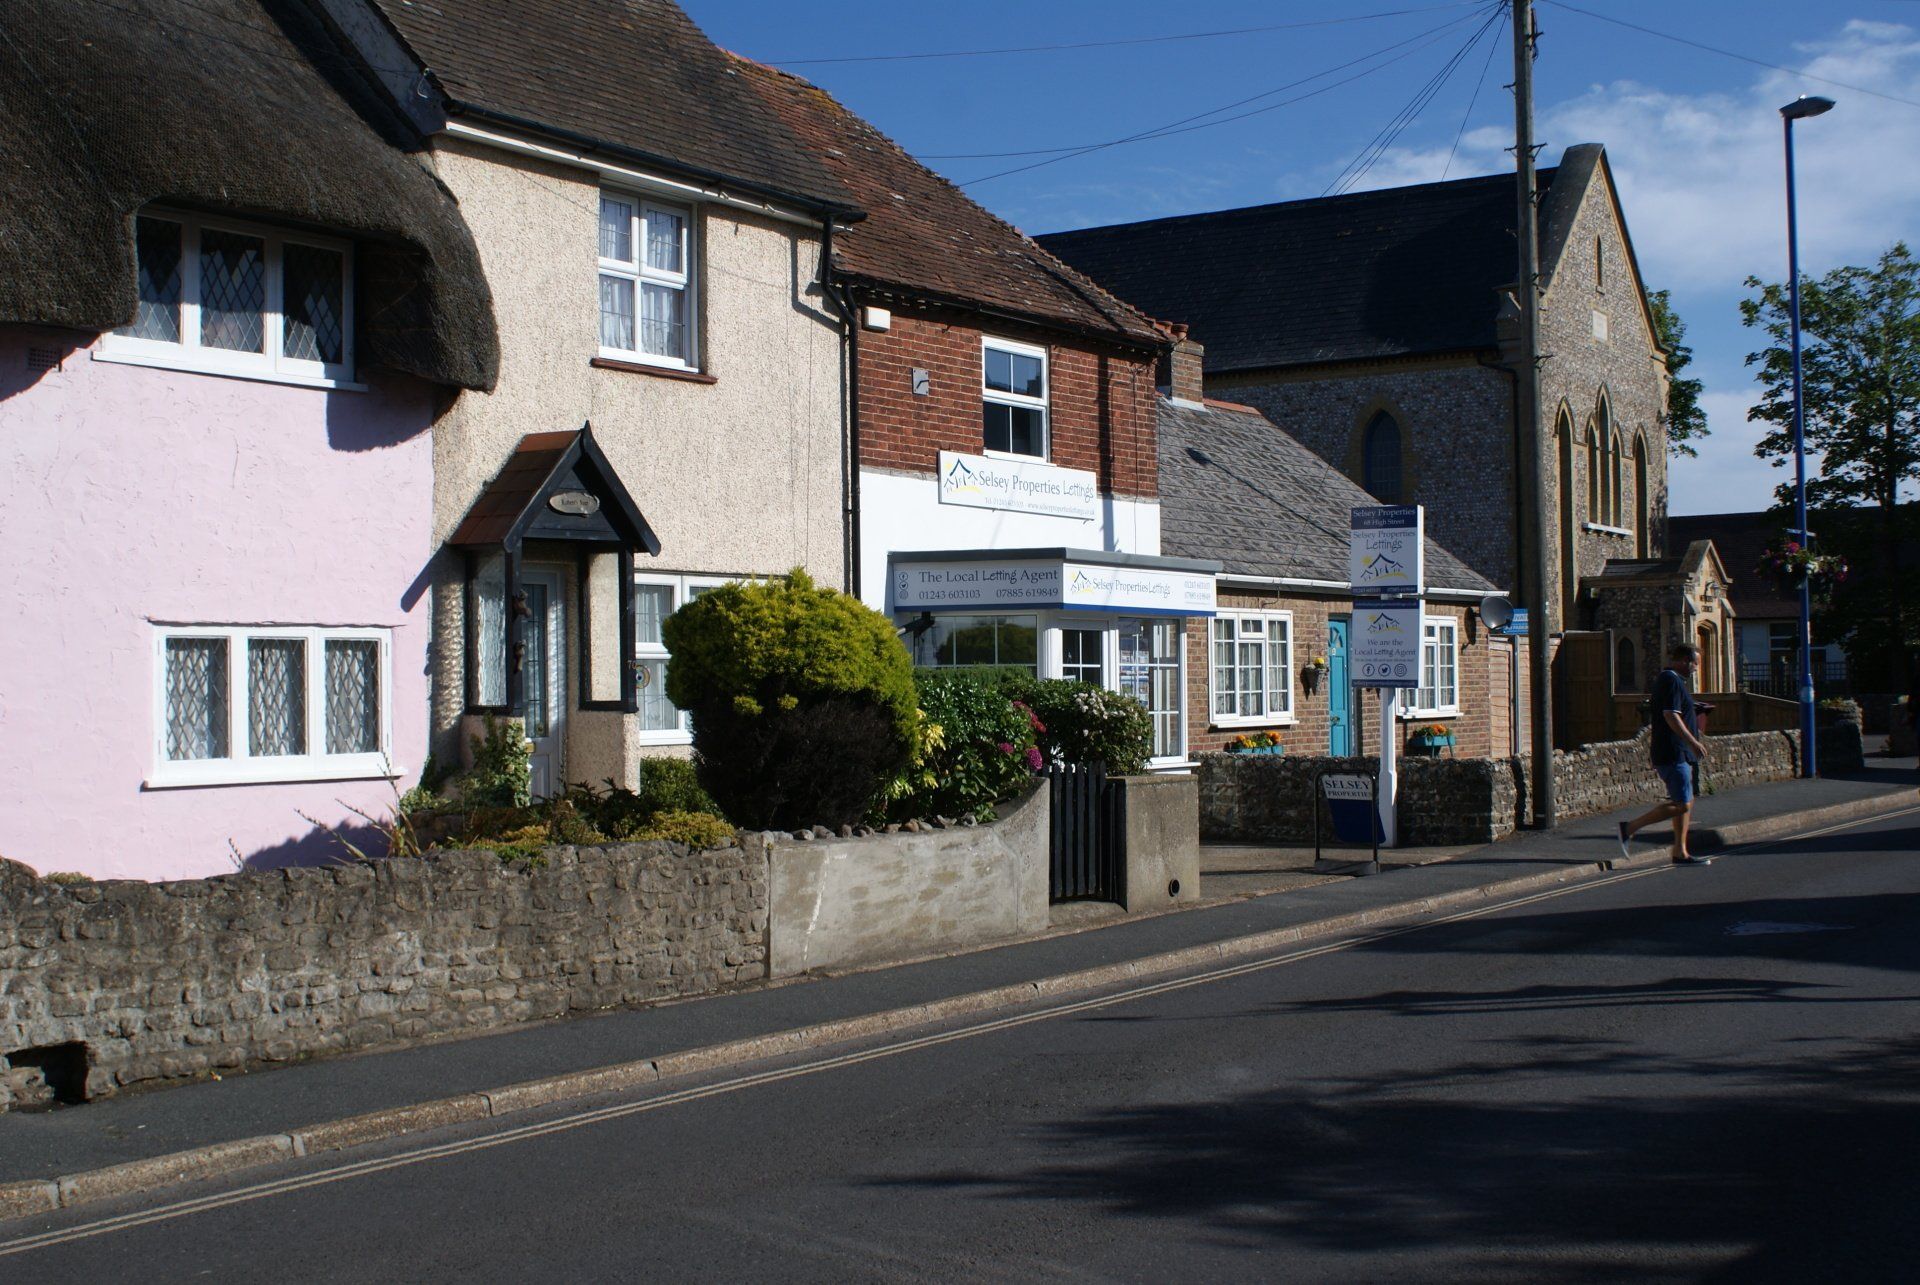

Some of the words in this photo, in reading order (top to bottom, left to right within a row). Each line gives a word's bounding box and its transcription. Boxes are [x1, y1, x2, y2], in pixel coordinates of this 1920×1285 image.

[979, 471, 1009, 493] Selsey
[1012, 475, 1060, 496] Properties
[1063, 480, 1093, 503] Lettings
[1353, 509, 1376, 519] Selsey
[1378, 508, 1416, 518] Properties
[1372, 518, 1387, 526] High
[1353, 531, 1376, 539] Selsey
[1378, 530, 1416, 539] Properties
[1366, 539, 1402, 553] Lettings
[918, 571, 945, 583] The
[946, 571, 978, 583] Local
[982, 569, 1017, 584] Letting
[1020, 569, 1059, 584] Agent
[996, 588, 1023, 599] 07885
[1025, 588, 1059, 598] 619849
[1092, 578, 1114, 594] Selsey
[1115, 579, 1149, 595] Properties
[1148, 581, 1171, 598] Lettings
[918, 590, 946, 600] 01243
[948, 589, 981, 599] 603103
[1374, 649, 1394, 658] Letting
[1394, 649, 1416, 657] Agent
[627, 659, 637, 671] 70
[1325, 780, 1371, 790] SELSEY
